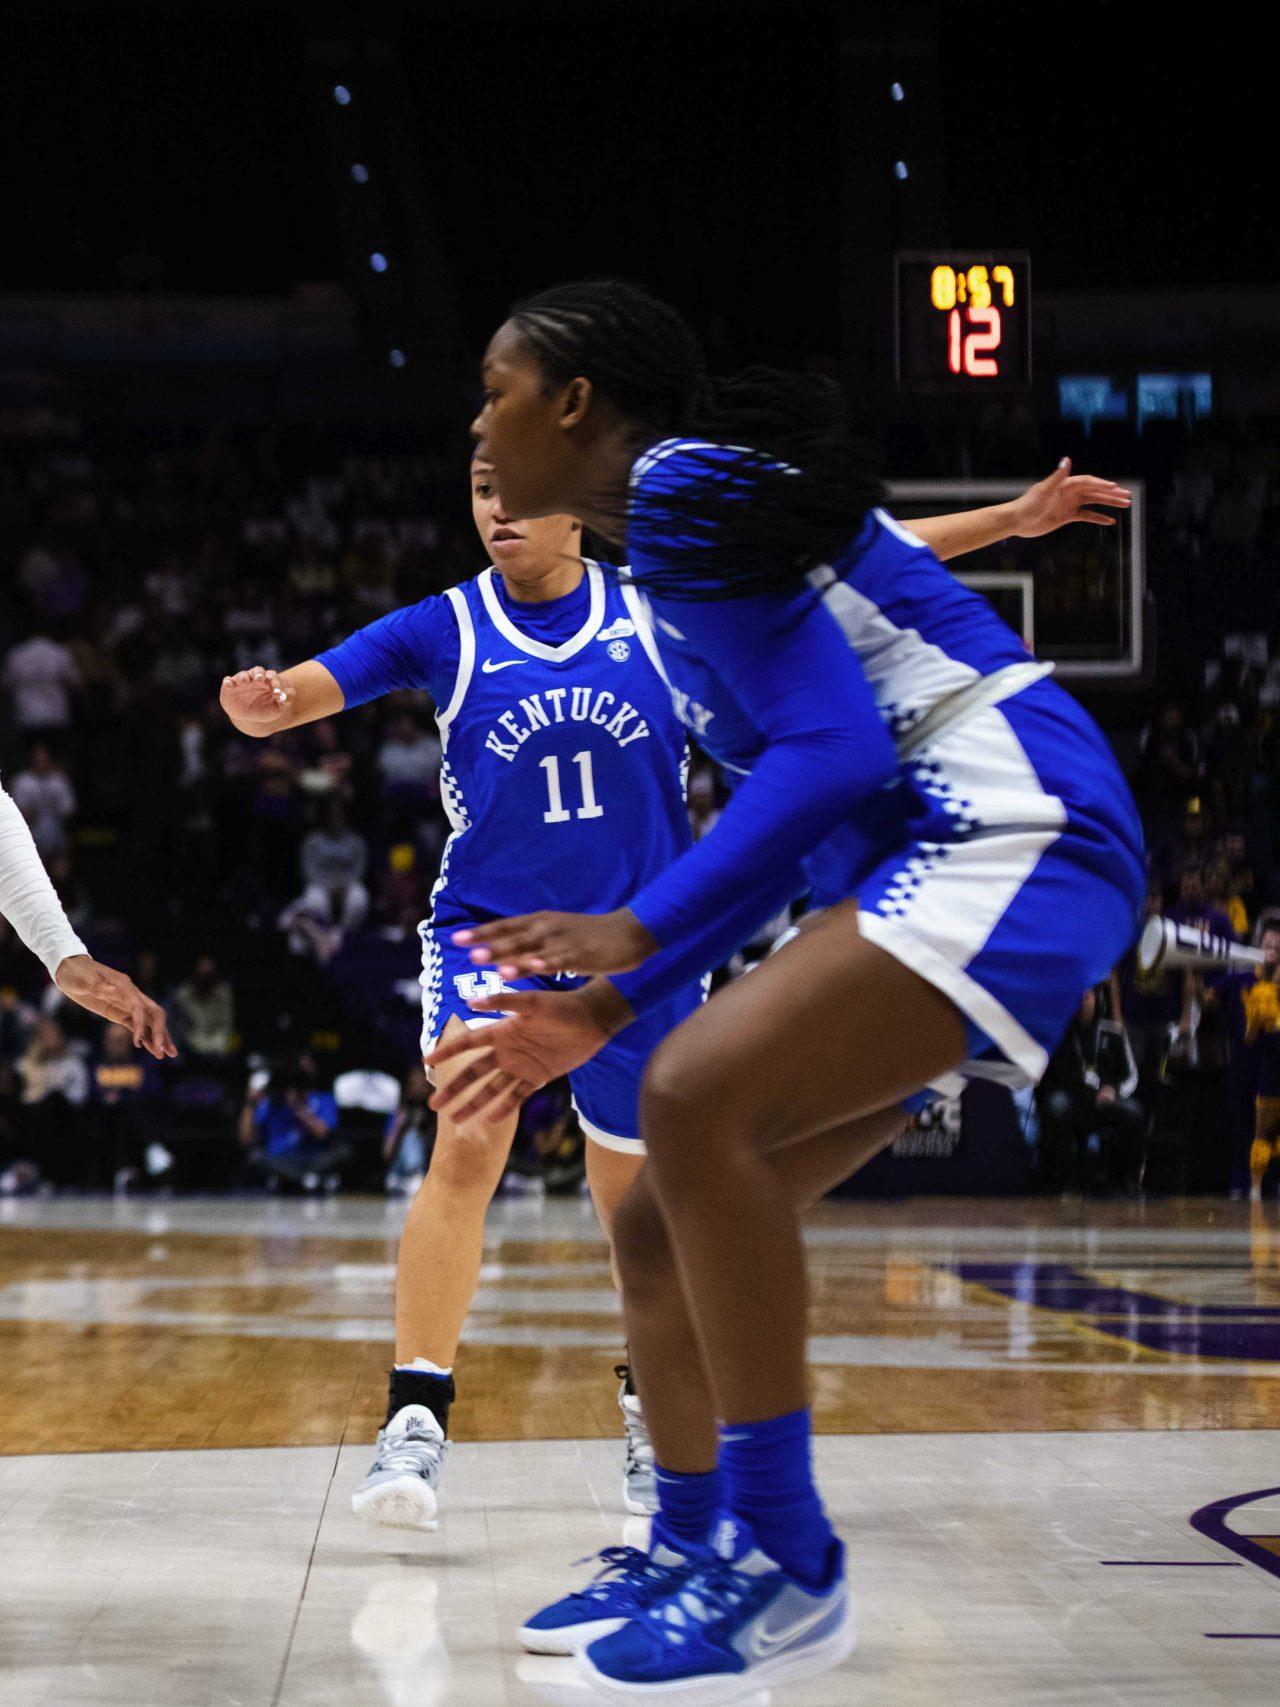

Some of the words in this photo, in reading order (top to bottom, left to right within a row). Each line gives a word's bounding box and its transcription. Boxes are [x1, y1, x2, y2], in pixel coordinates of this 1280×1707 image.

[948, 306, 1001, 377] 12
[485, 687, 649, 762] KENTUCKY
[539, 751, 603, 823] 11
